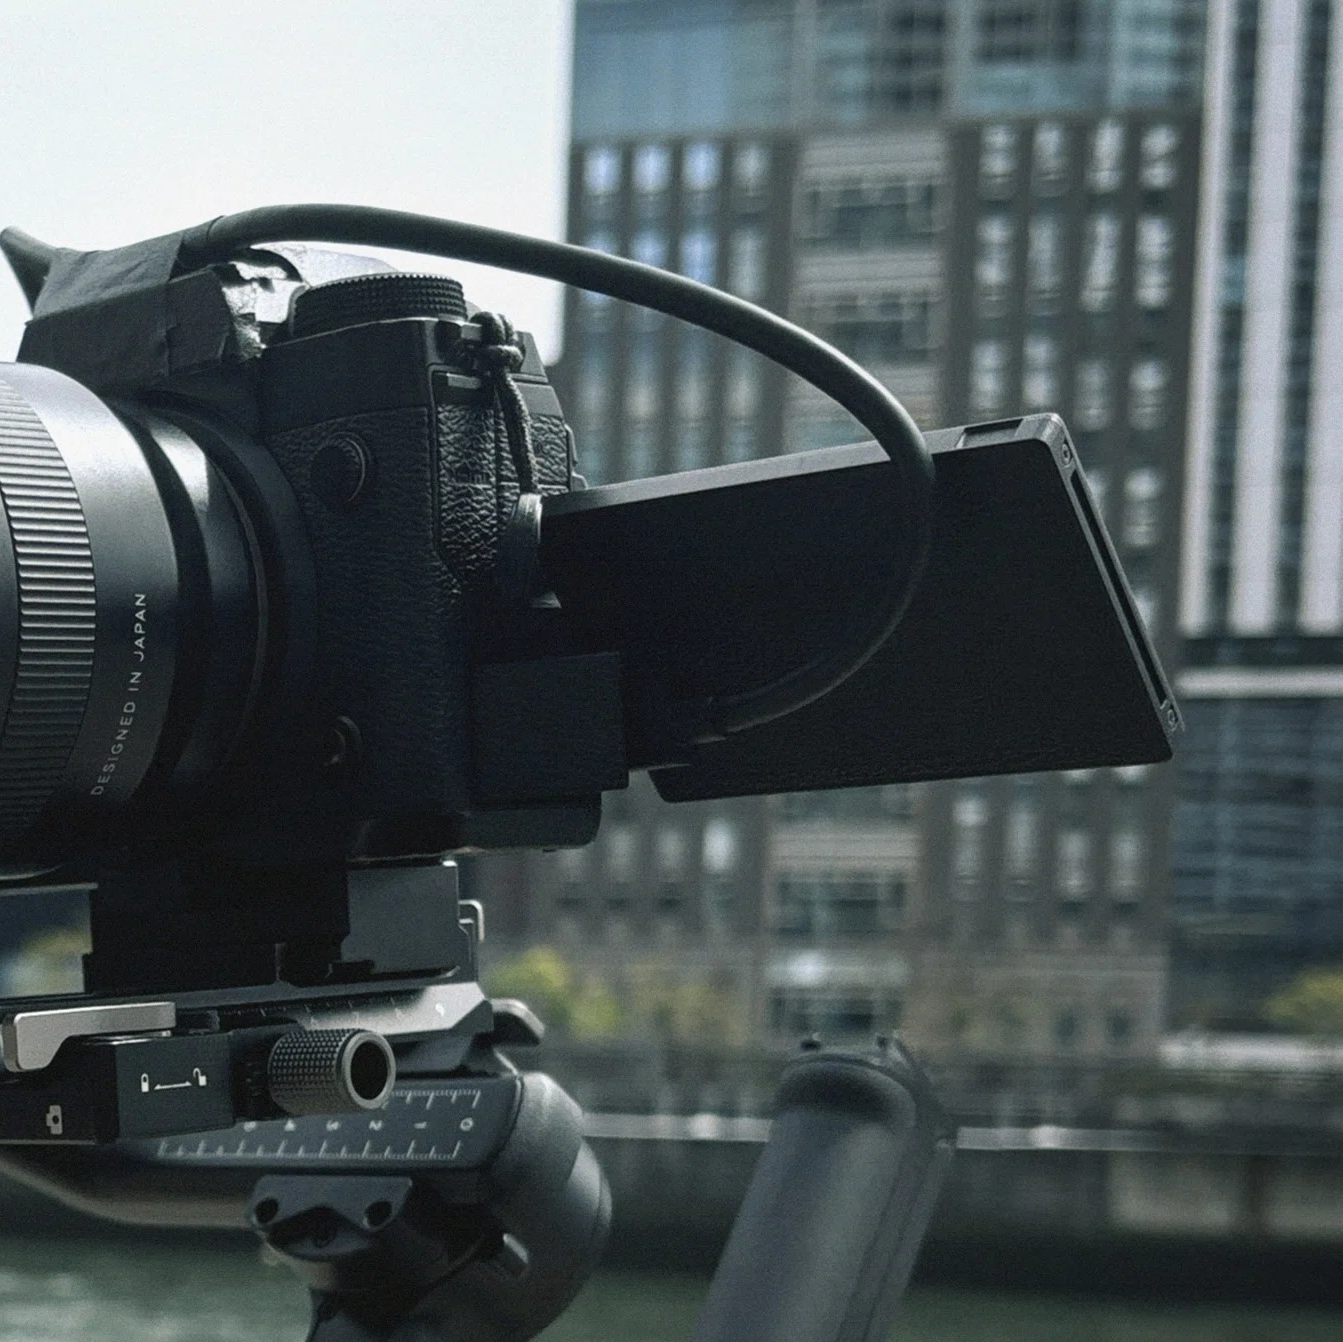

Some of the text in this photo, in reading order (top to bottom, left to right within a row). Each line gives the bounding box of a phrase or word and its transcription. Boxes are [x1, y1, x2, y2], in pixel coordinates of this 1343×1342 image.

[90, 593, 148, 796] DESIGNED IN JAPAN
